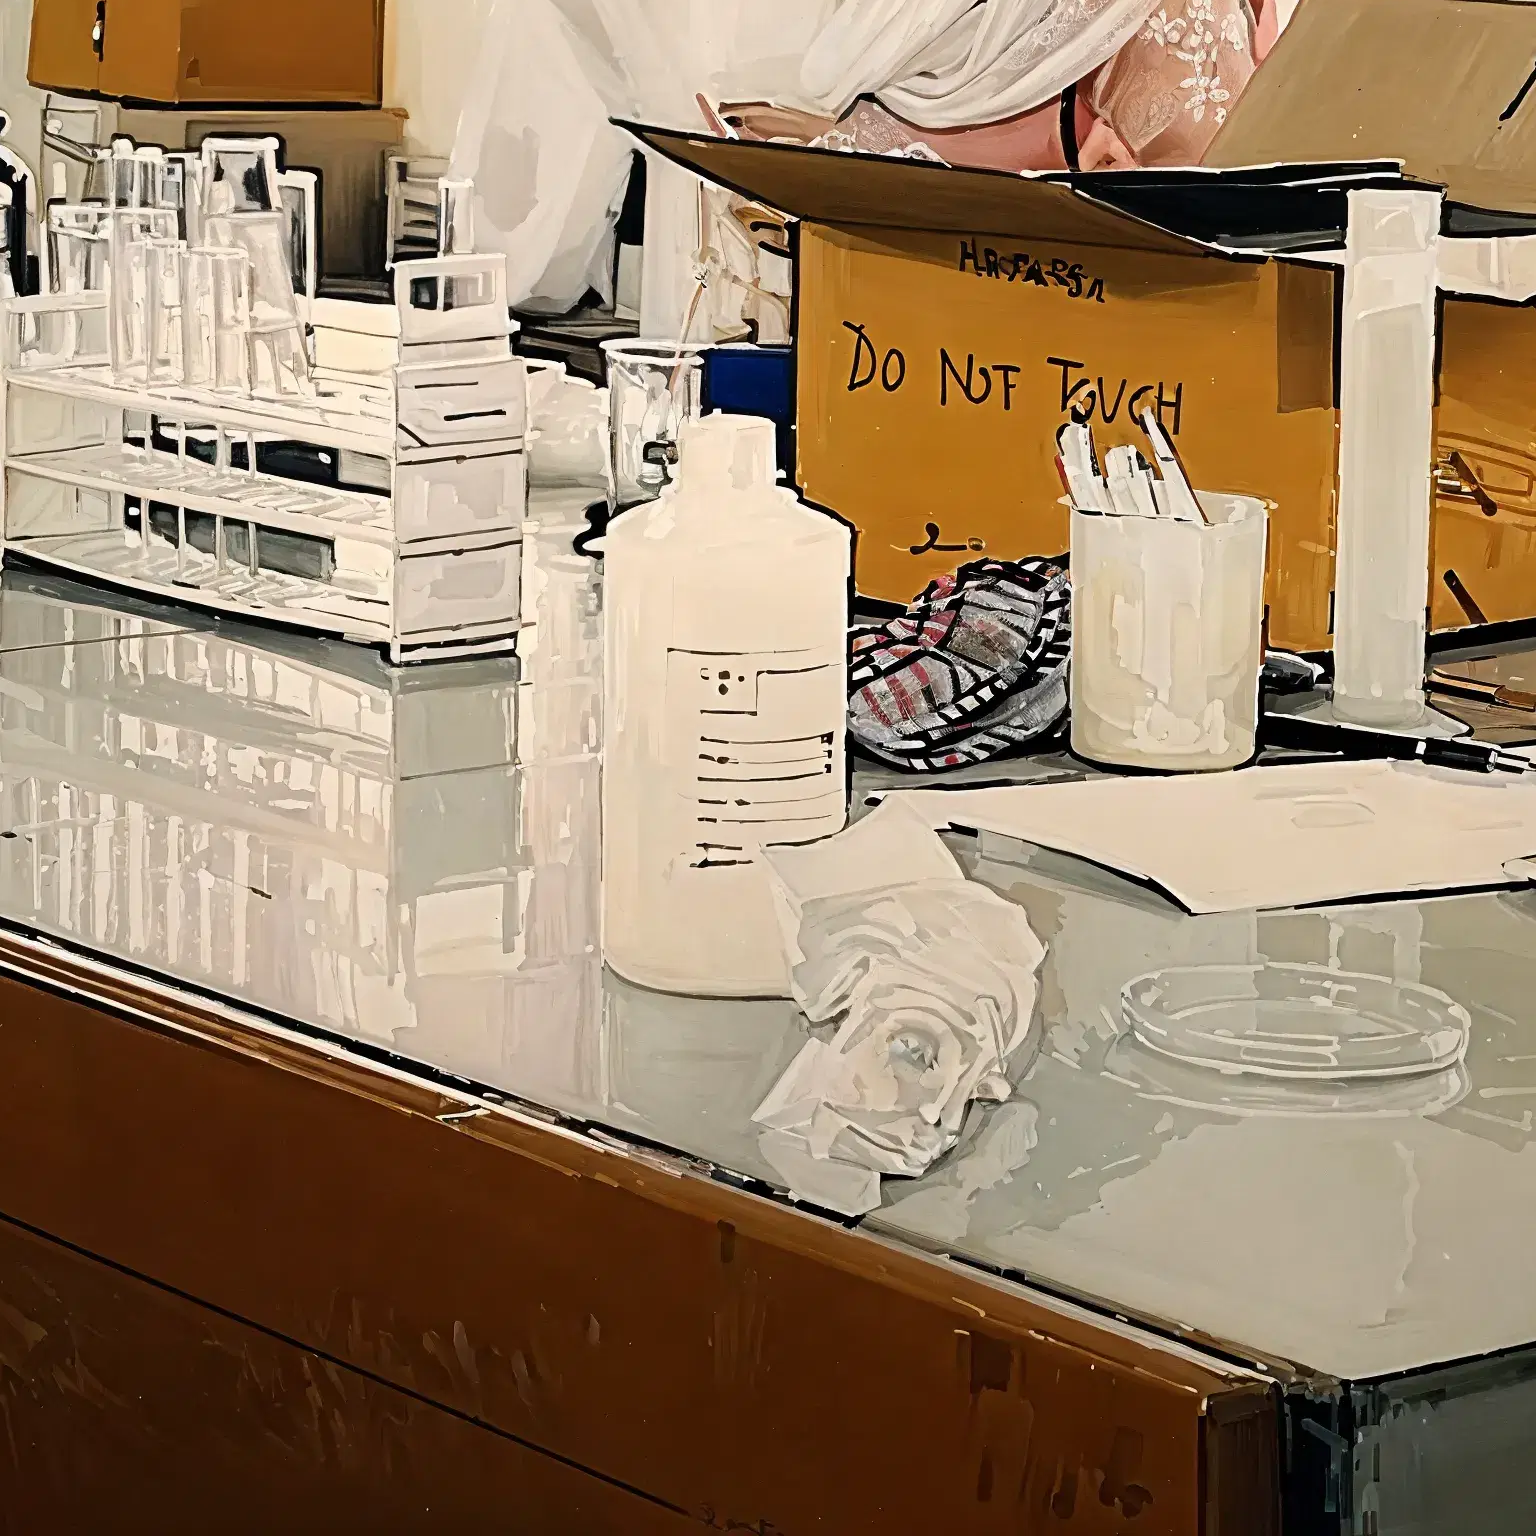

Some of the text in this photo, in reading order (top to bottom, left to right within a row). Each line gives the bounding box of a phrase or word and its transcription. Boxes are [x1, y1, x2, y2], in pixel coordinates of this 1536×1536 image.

[842, 319, 1184, 436] DO NOT TOUCH
